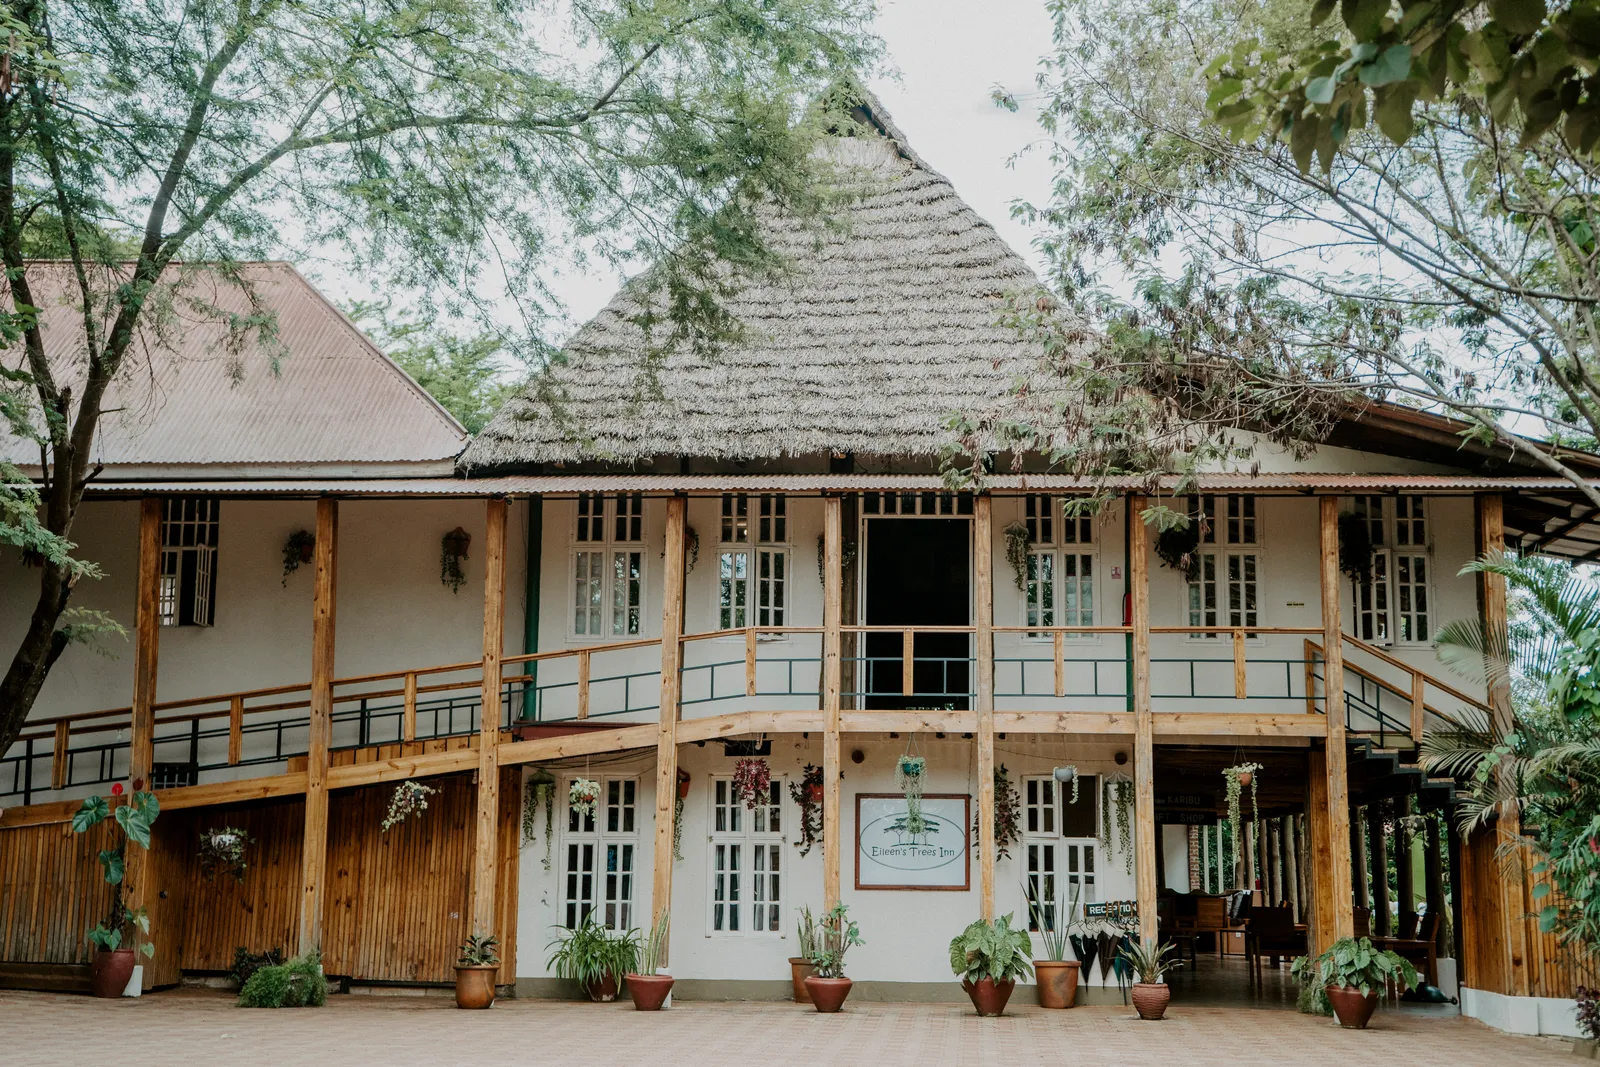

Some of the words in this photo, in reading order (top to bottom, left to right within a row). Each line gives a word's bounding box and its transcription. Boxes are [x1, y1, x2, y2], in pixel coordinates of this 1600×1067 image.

[1167, 795, 1201, 805] KARIBU
[1155, 813, 1171, 822] IFT
[1180, 813, 1205, 823] SHOP
[871, 846, 907, 857] Eileen's
[908, 847, 937, 857] Trees
[939, 846, 955, 858] Inn
